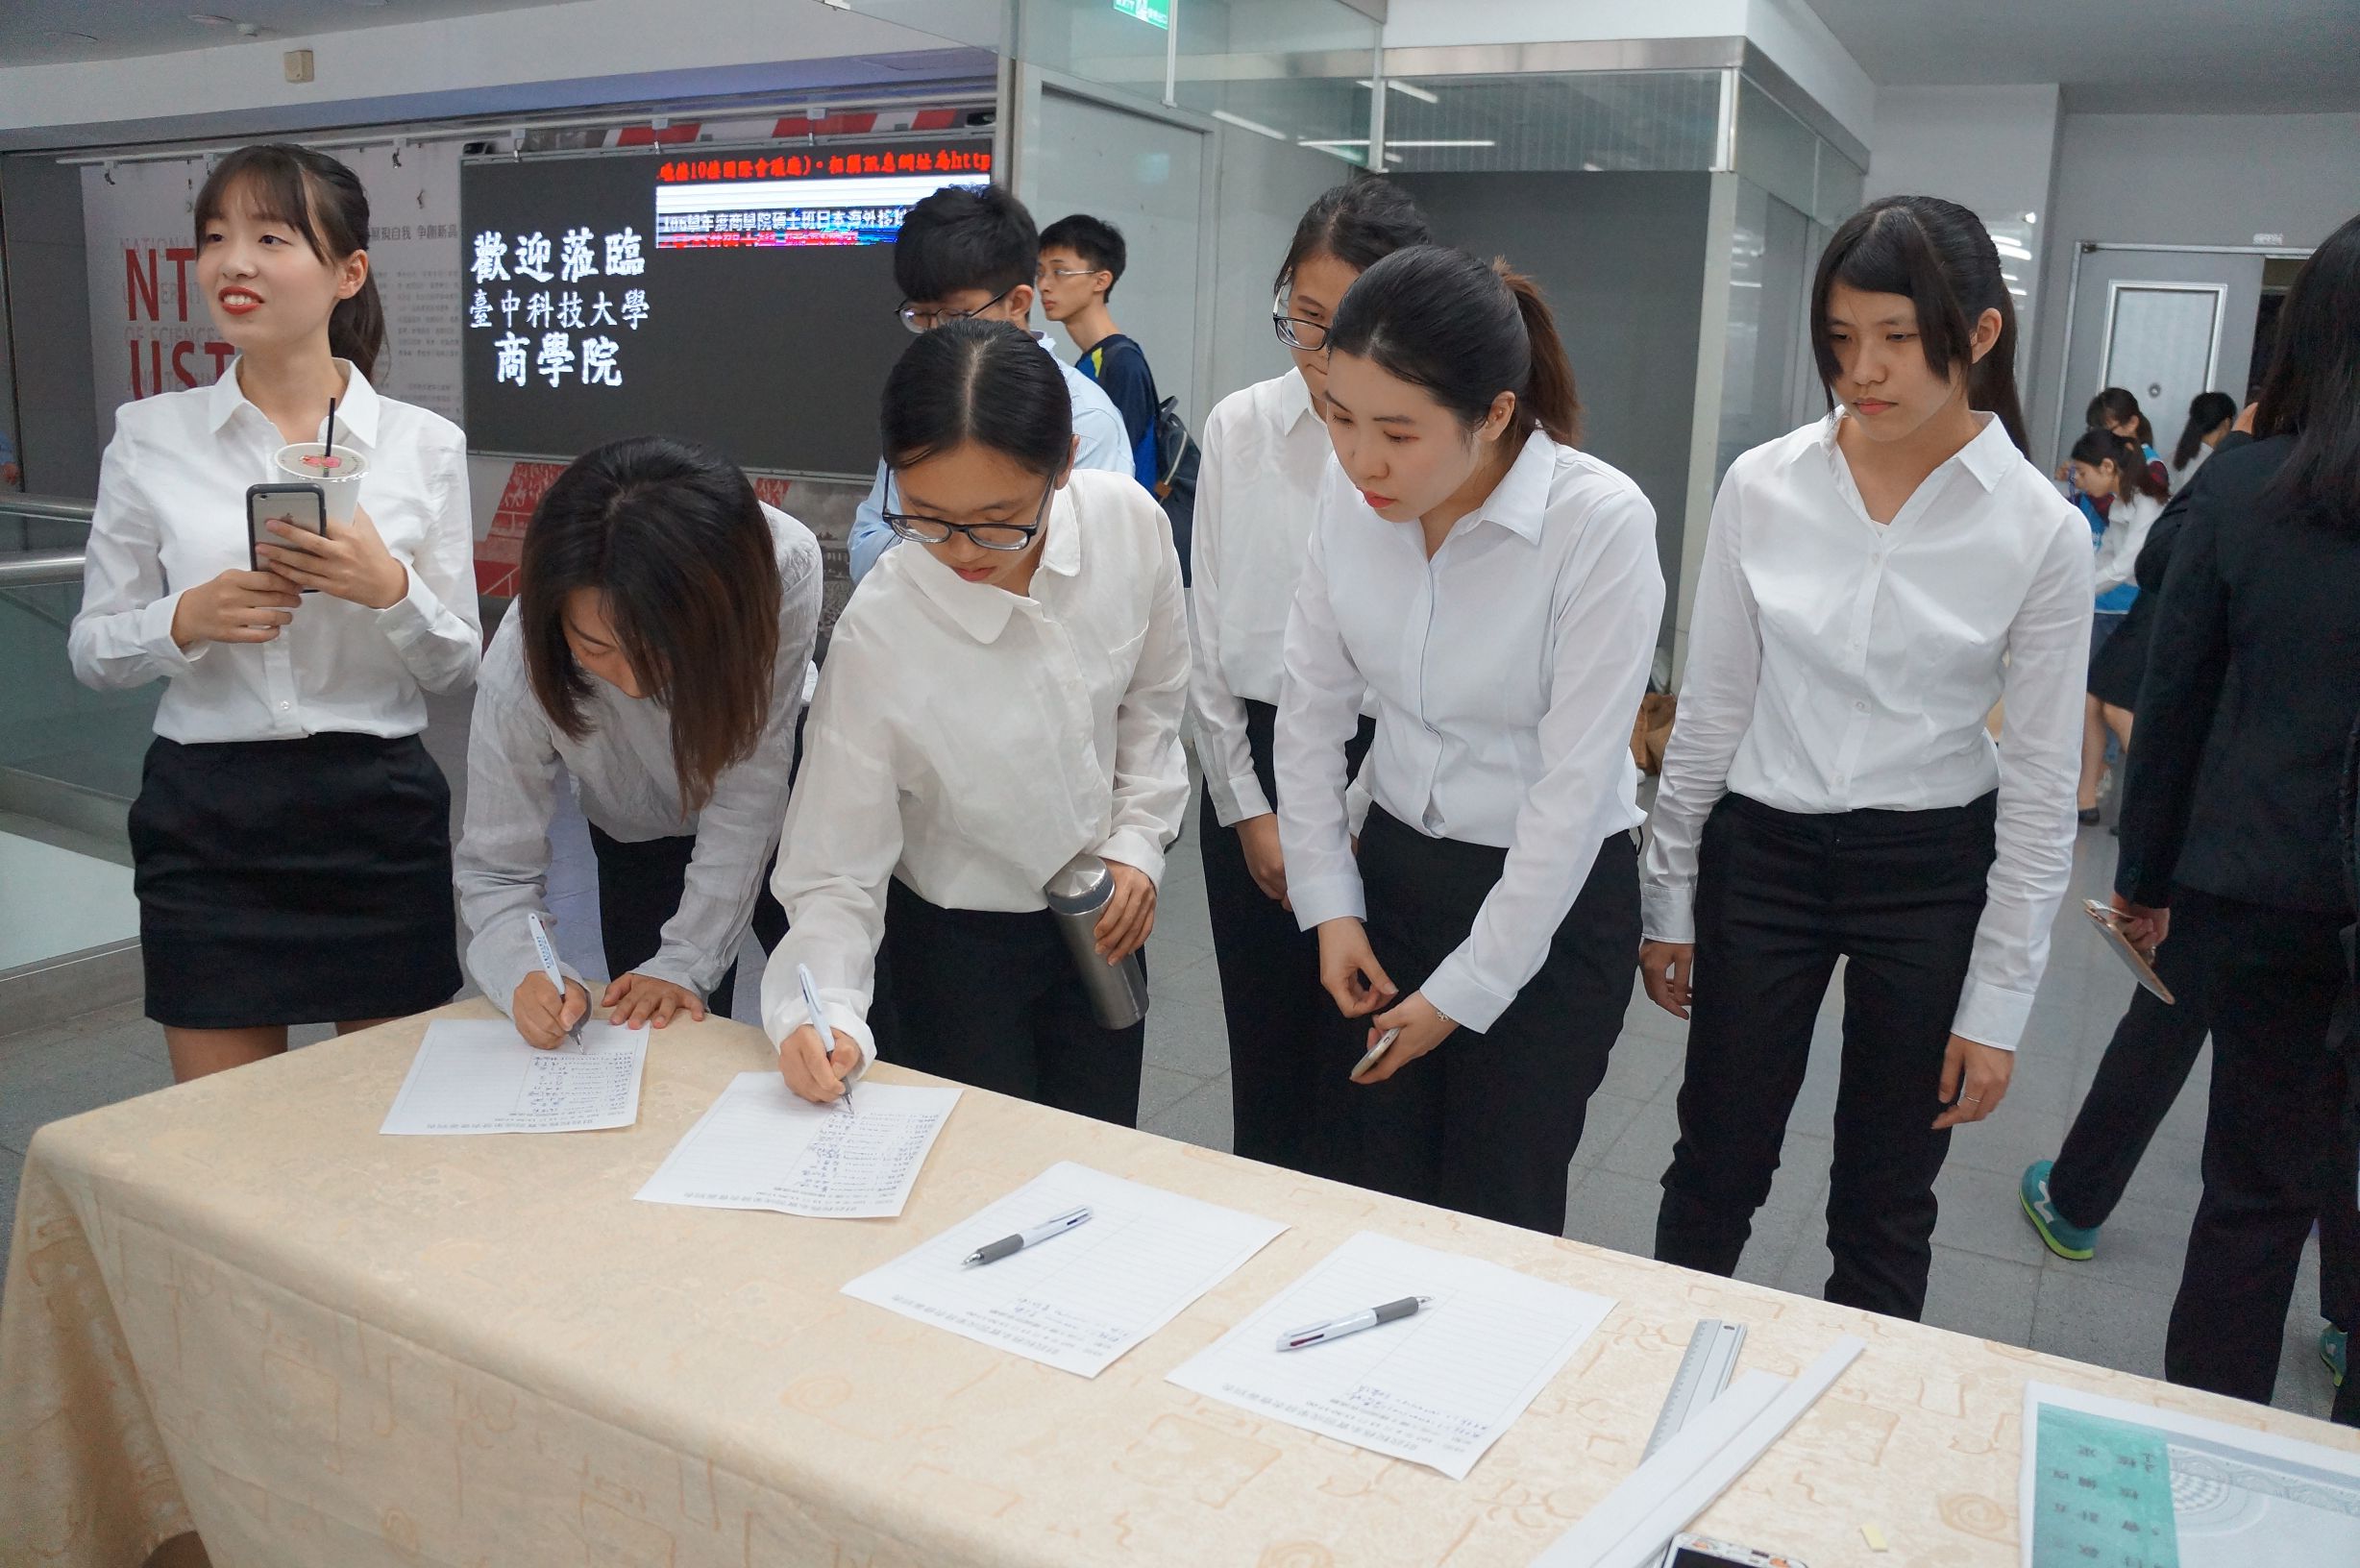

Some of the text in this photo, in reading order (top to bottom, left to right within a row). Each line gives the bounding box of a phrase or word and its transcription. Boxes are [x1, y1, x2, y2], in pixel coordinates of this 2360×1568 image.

[470, 226, 646, 284] 歡迎蒞臨
[469, 288, 651, 330] 臺中科技大學
[494, 331, 623, 388] 商學院
